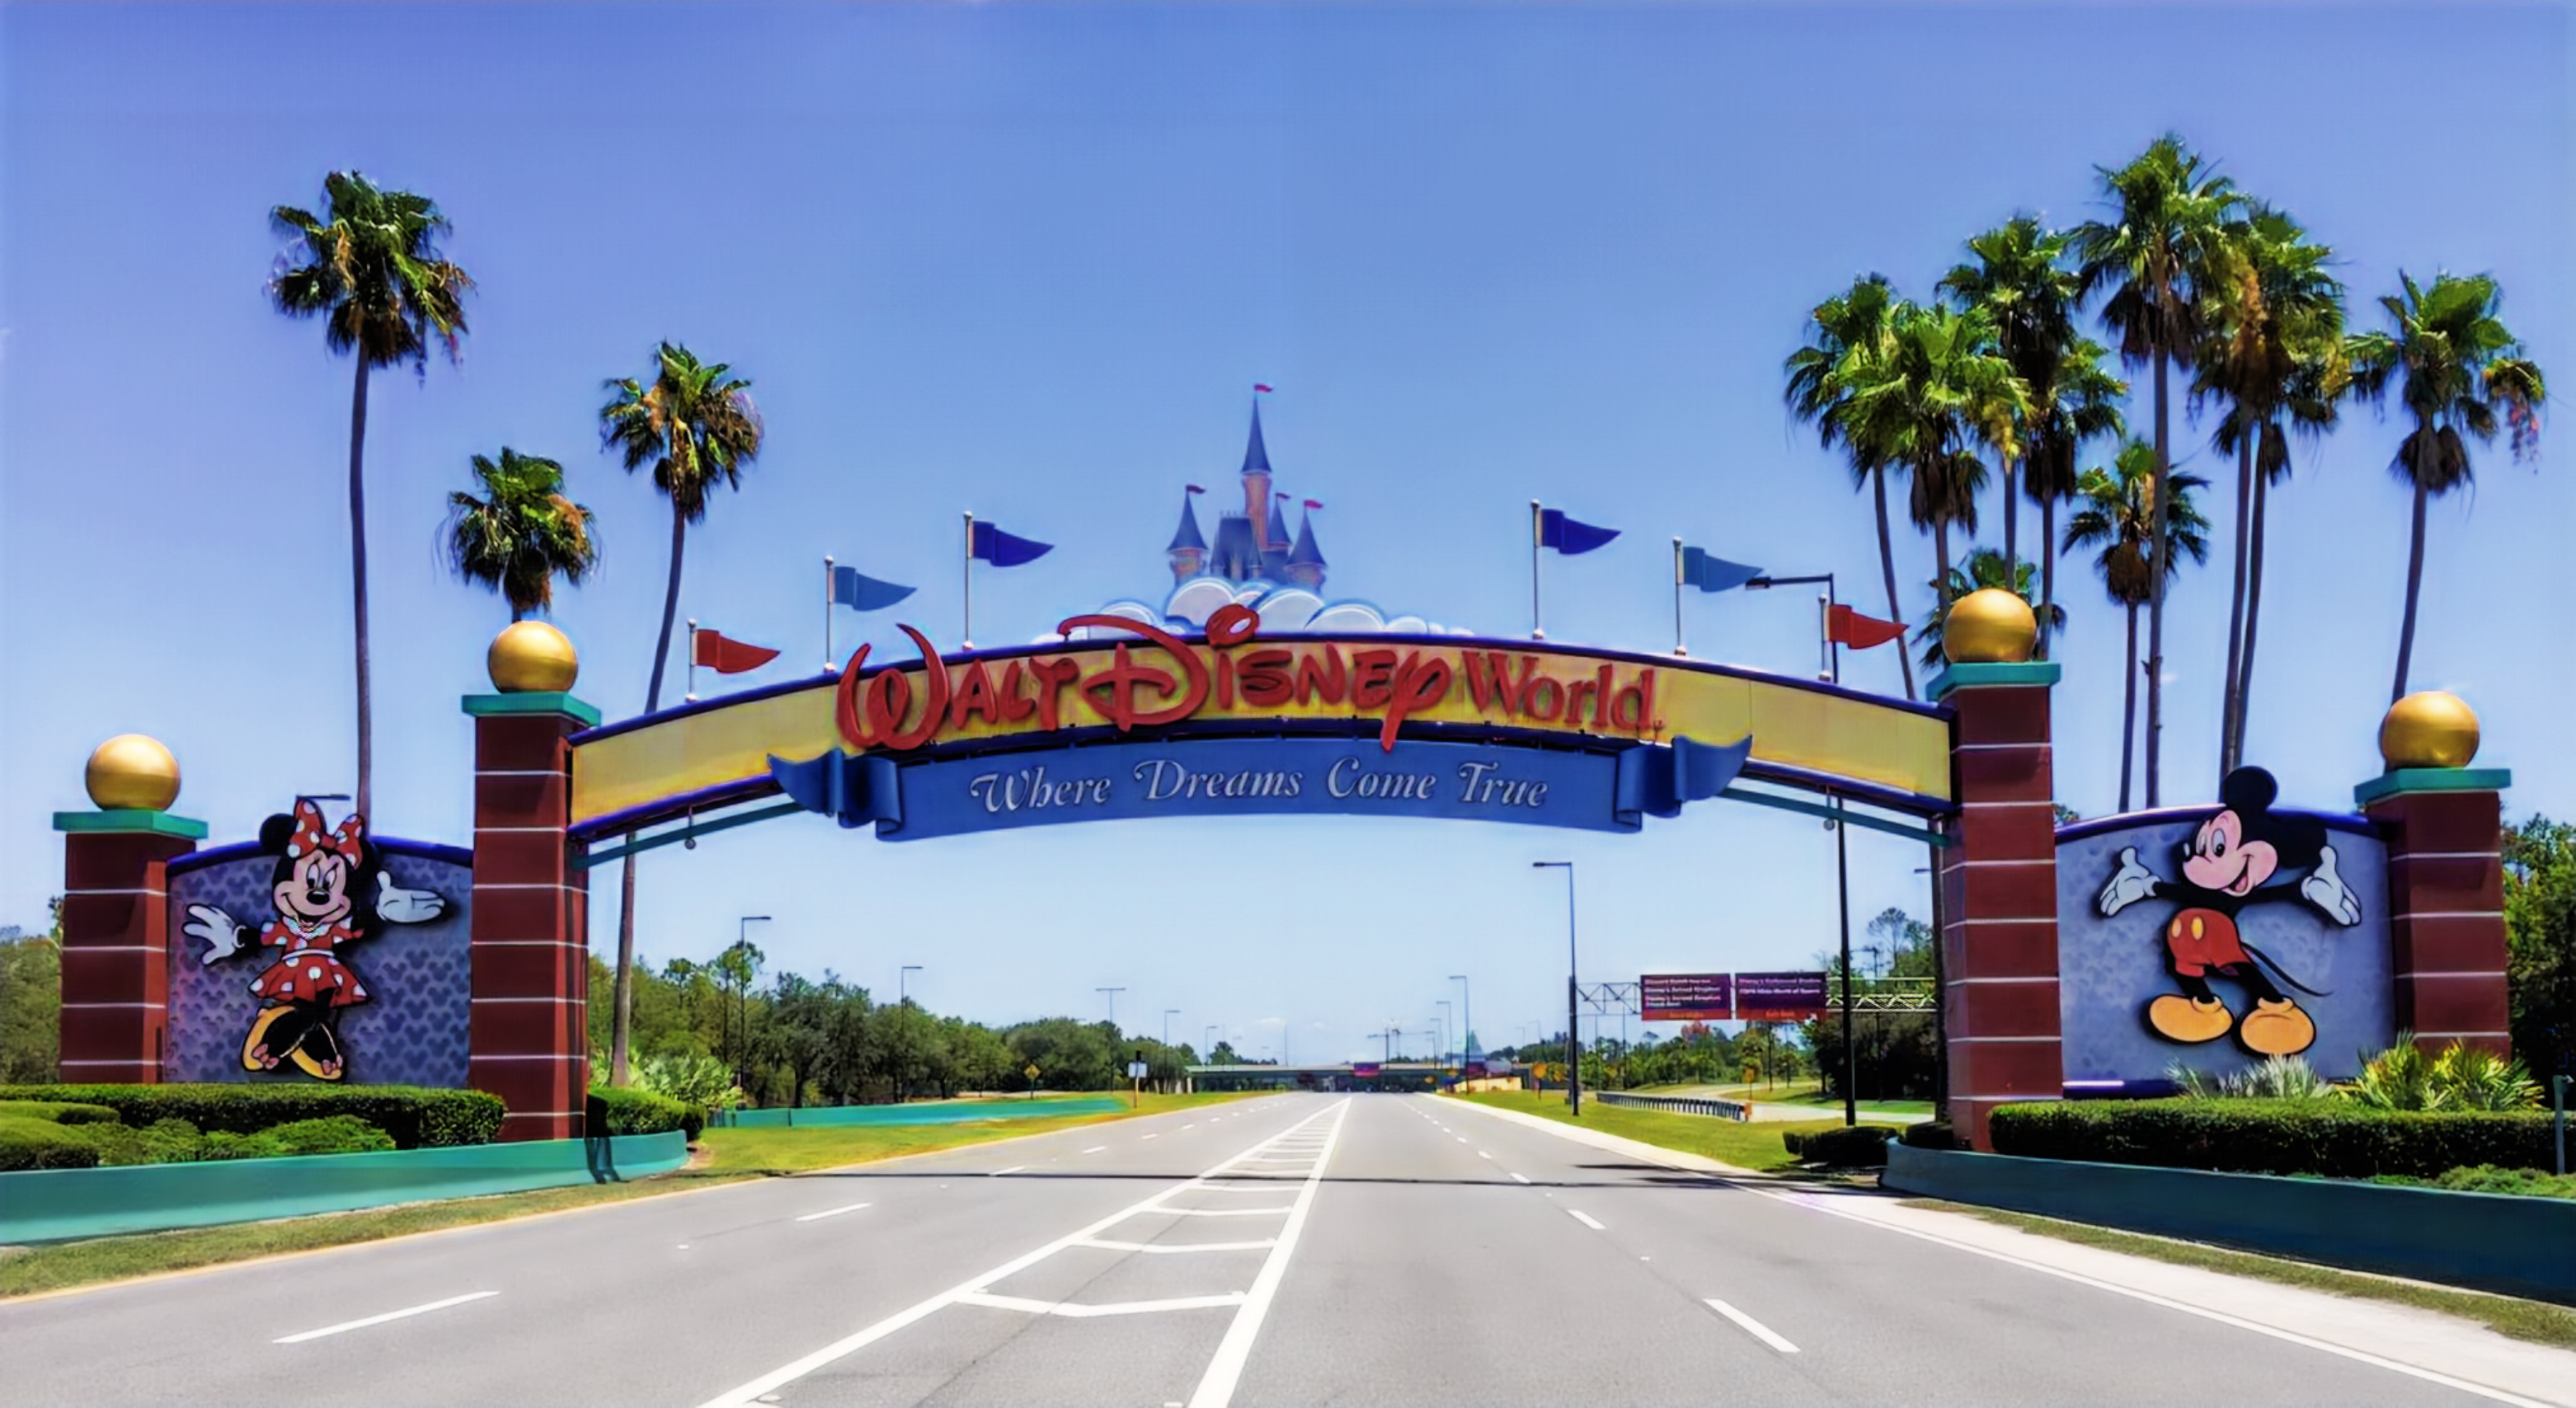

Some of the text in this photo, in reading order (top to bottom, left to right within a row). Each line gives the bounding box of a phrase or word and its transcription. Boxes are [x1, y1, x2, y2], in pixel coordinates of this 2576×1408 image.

[837, 623, 1079, 750] WALT
[1461, 650, 1654, 729] World
[971, 757, 1549, 812] Where Dreams Come True
